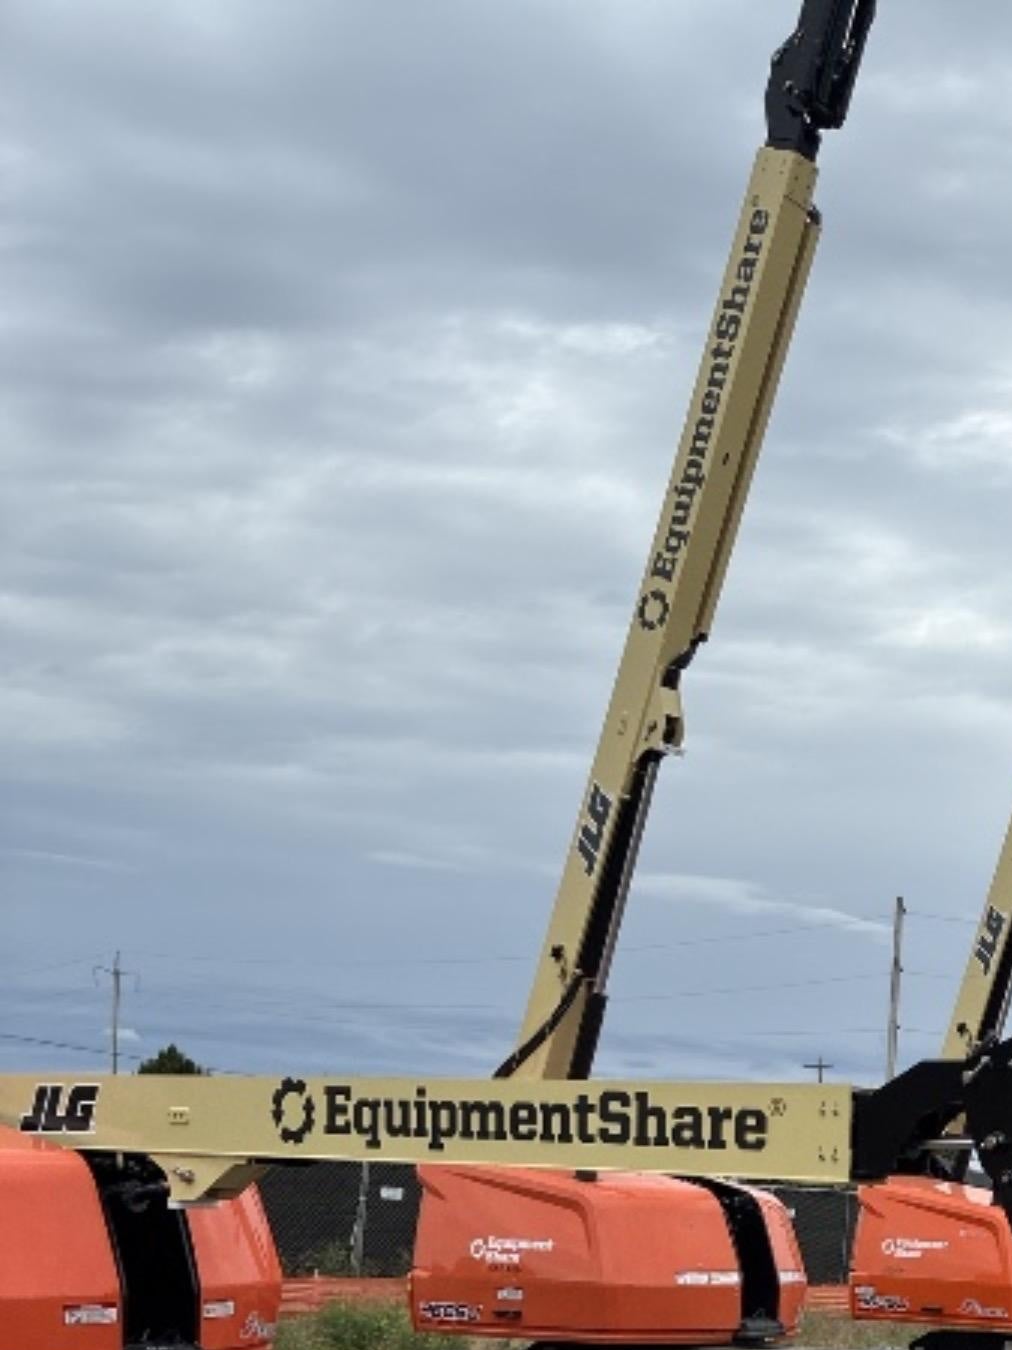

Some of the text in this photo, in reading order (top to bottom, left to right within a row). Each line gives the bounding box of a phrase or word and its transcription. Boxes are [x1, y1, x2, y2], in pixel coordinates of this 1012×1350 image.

[577, 782, 612, 877] JLG
[975, 905, 1005, 977] JLG
[19, 1084, 100, 1133] JLG
